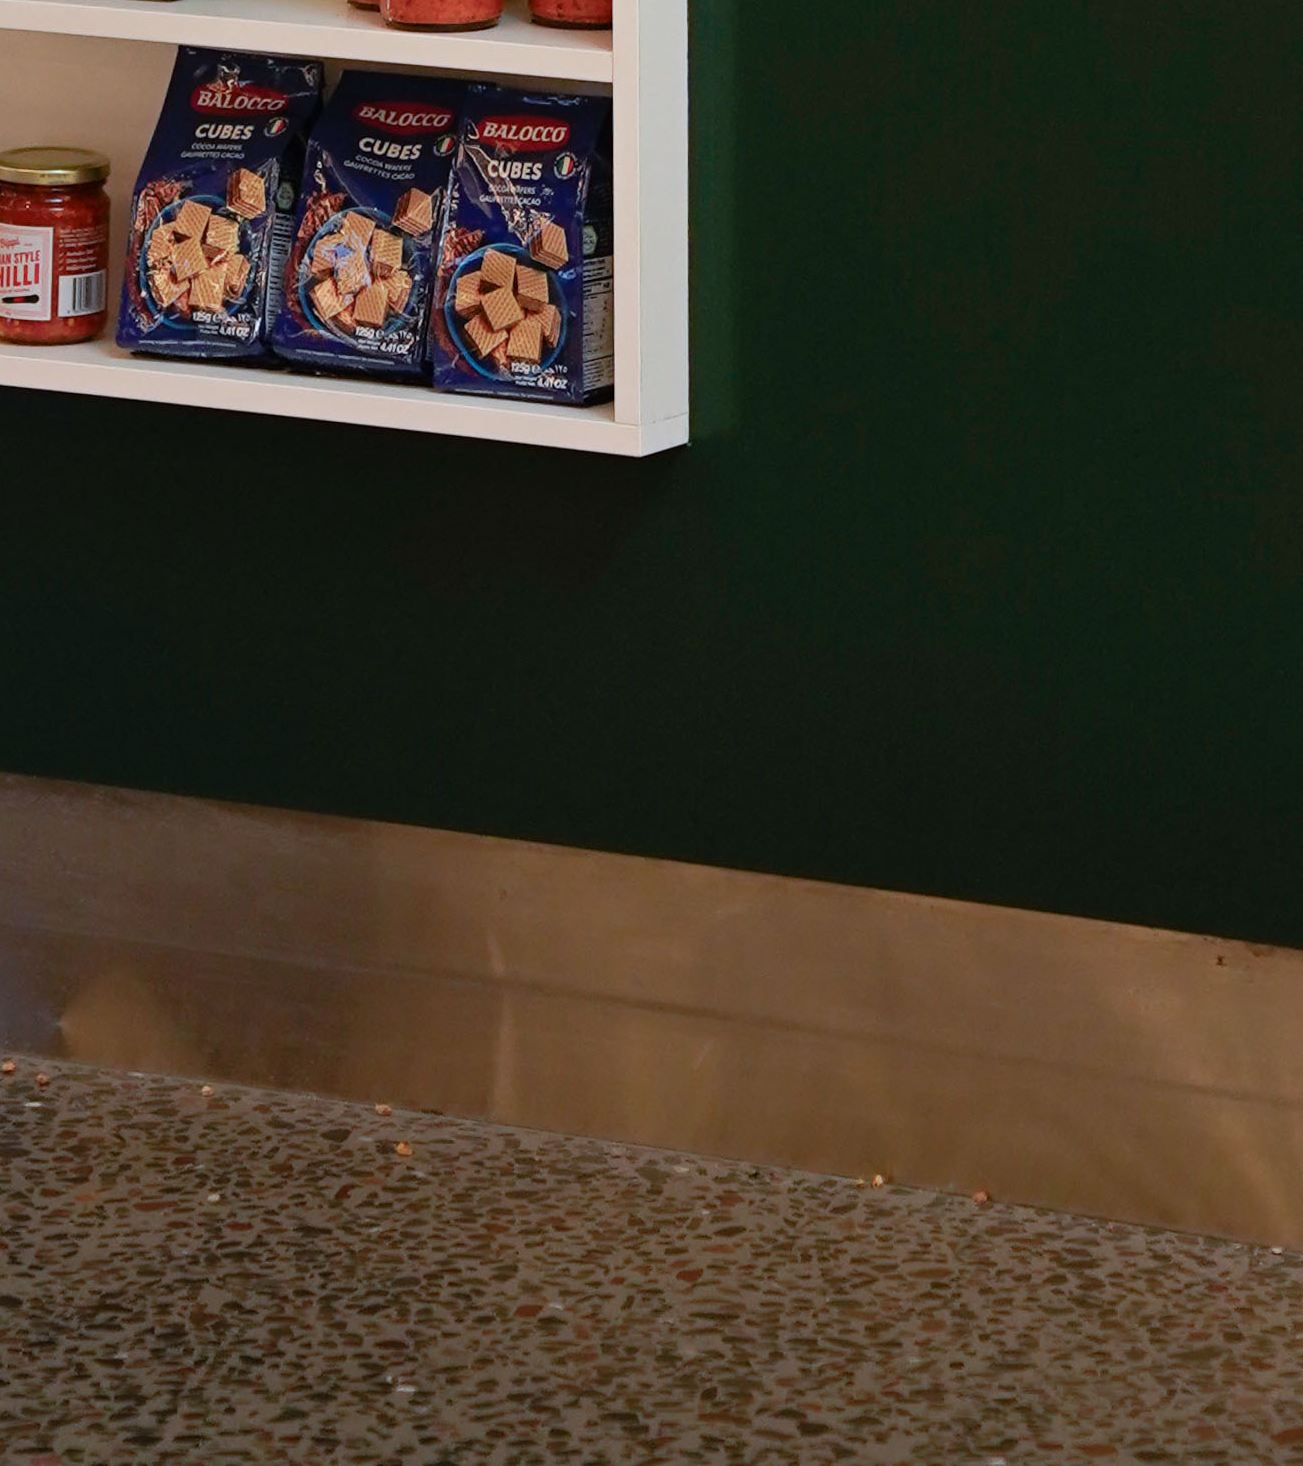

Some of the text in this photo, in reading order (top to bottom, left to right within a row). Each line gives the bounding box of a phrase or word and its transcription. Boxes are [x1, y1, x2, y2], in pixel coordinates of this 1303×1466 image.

[197, 90, 286, 112] BALOCCO
[357, 105, 451, 129] BALOCCO
[195, 123, 254, 141] CUBES
[482, 122, 568, 143] BALOCCO
[358, 136, 423, 161] CUBES
[487, 159, 543, 182] CUBES
[13, 250, 42, 265] STYLE
[510, 362, 532, 375] 125g
